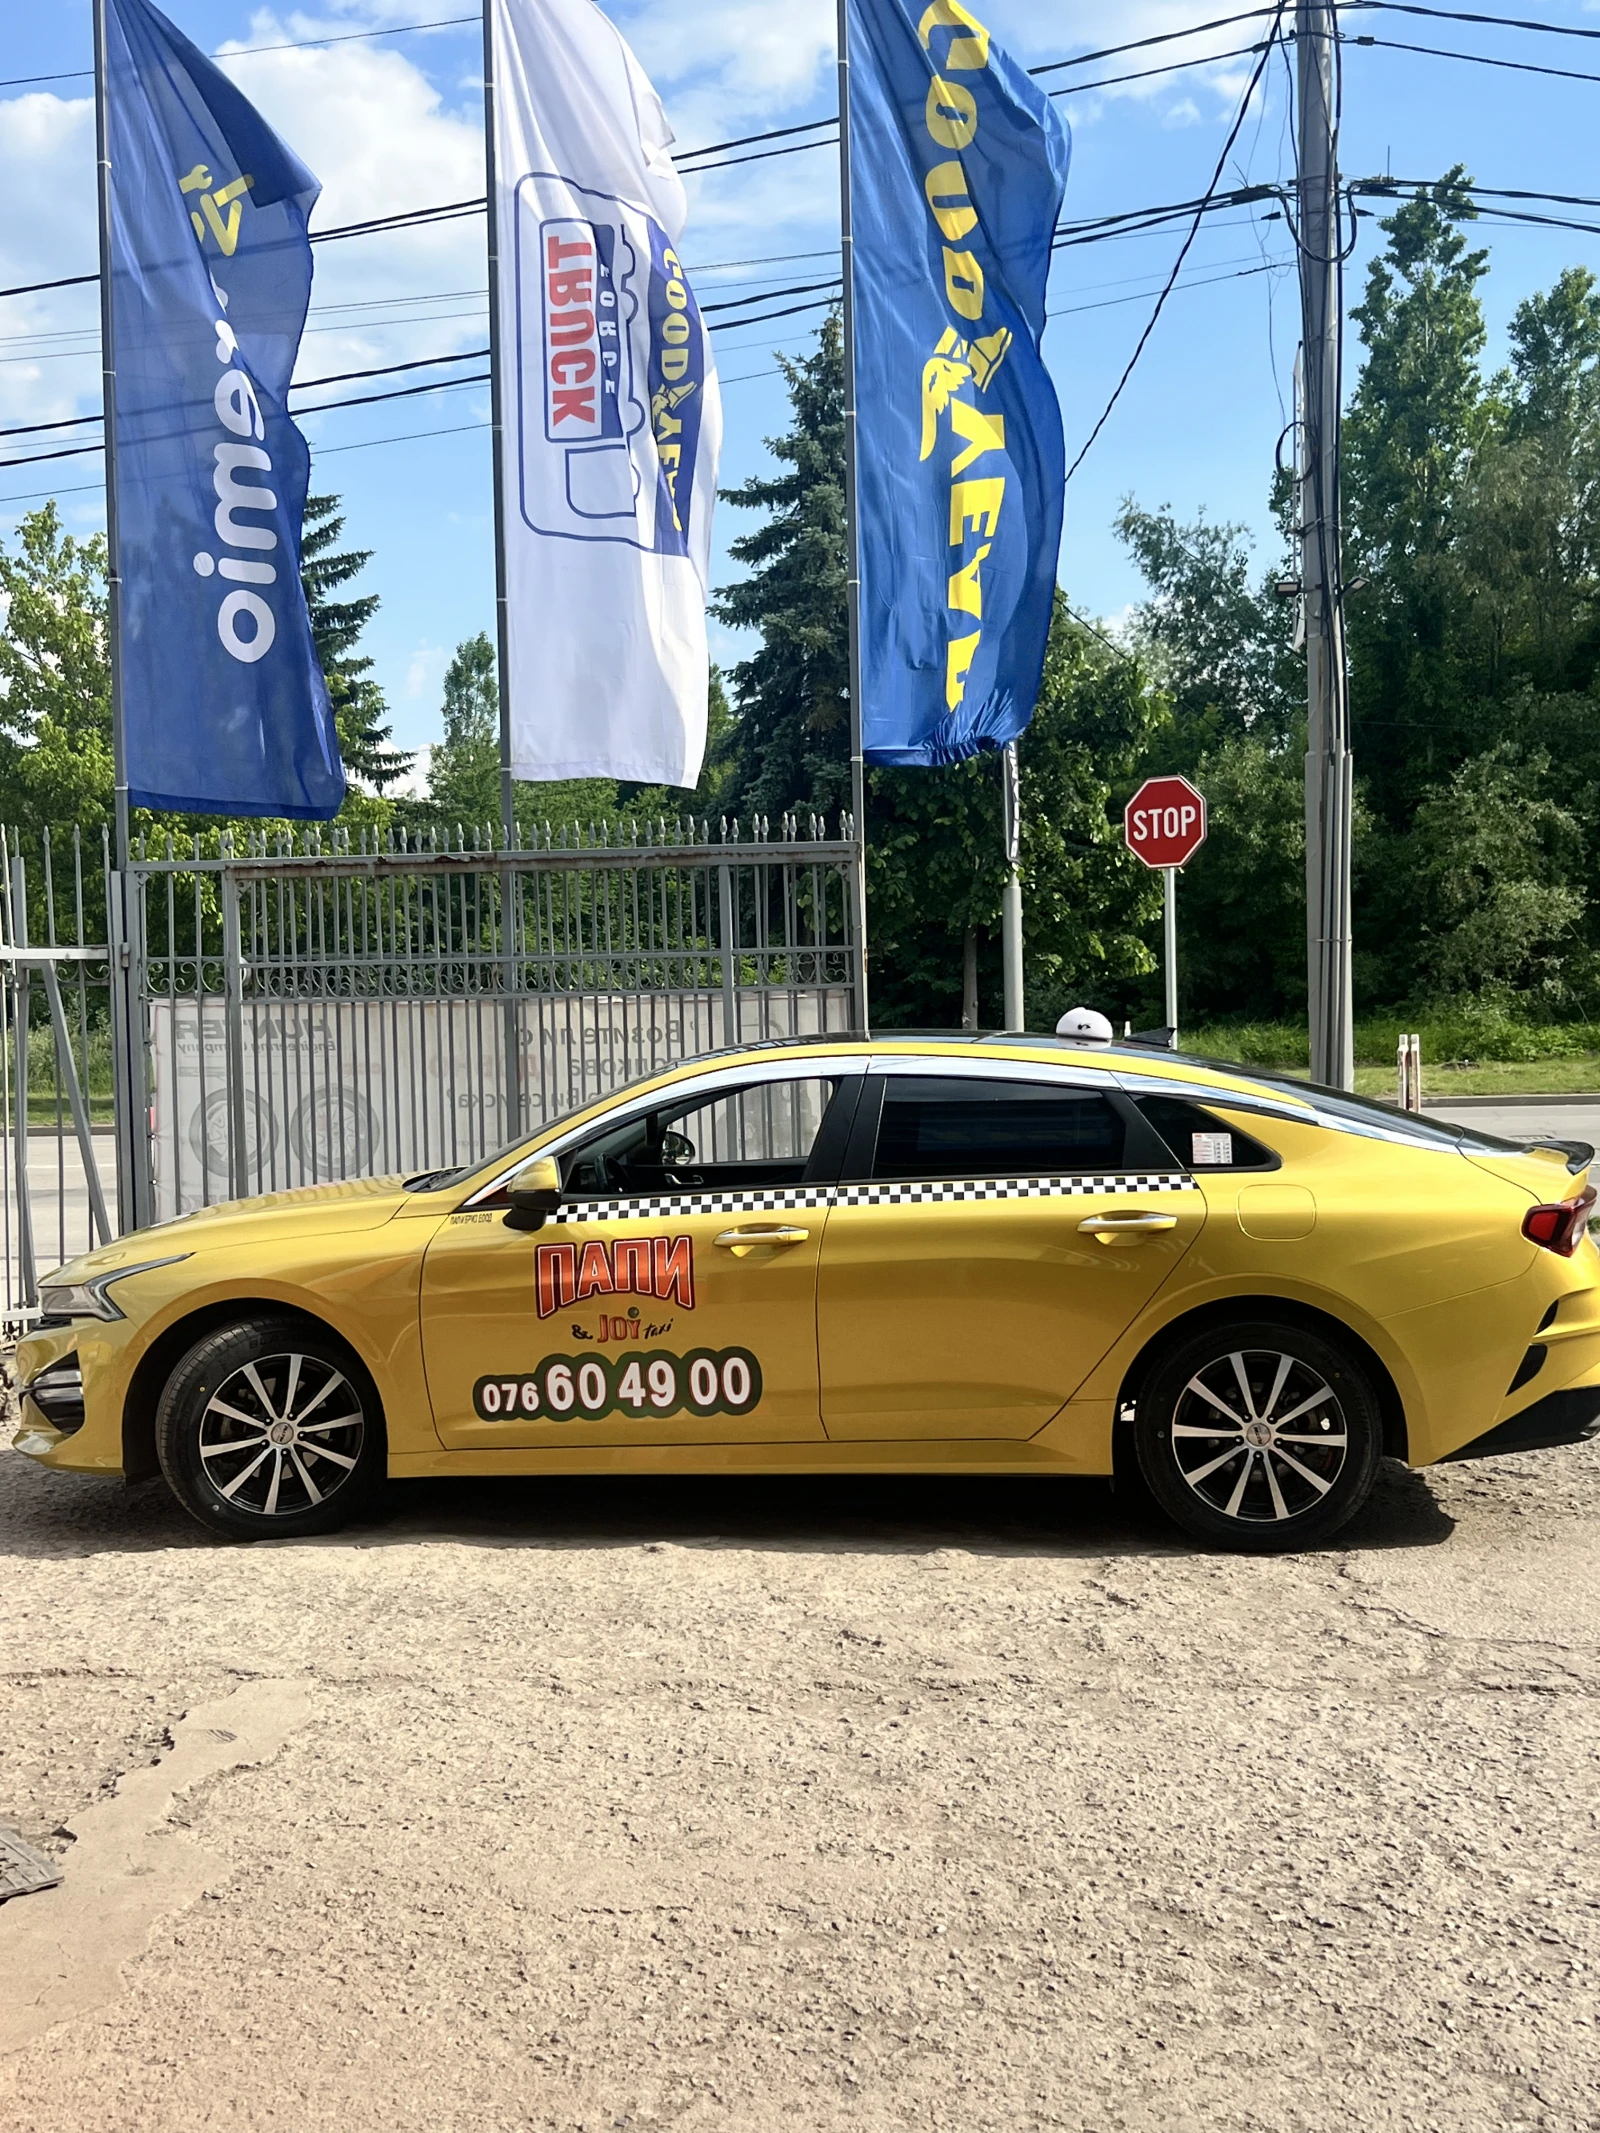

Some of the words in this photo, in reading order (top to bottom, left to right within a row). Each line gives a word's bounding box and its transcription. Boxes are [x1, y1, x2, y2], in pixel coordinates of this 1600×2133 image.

[1133, 805, 1196, 842] STOP
[535, 1235, 695, 1318] ПАПИ
[571, 1324, 593, 1340] &
[597, 1309, 641, 1343] JOY
[482, 1382, 540, 1413] 076
[547, 1362, 607, 1411] 60
[618, 1360, 677, 1408] 49
[689, 1356, 751, 1407] 00
